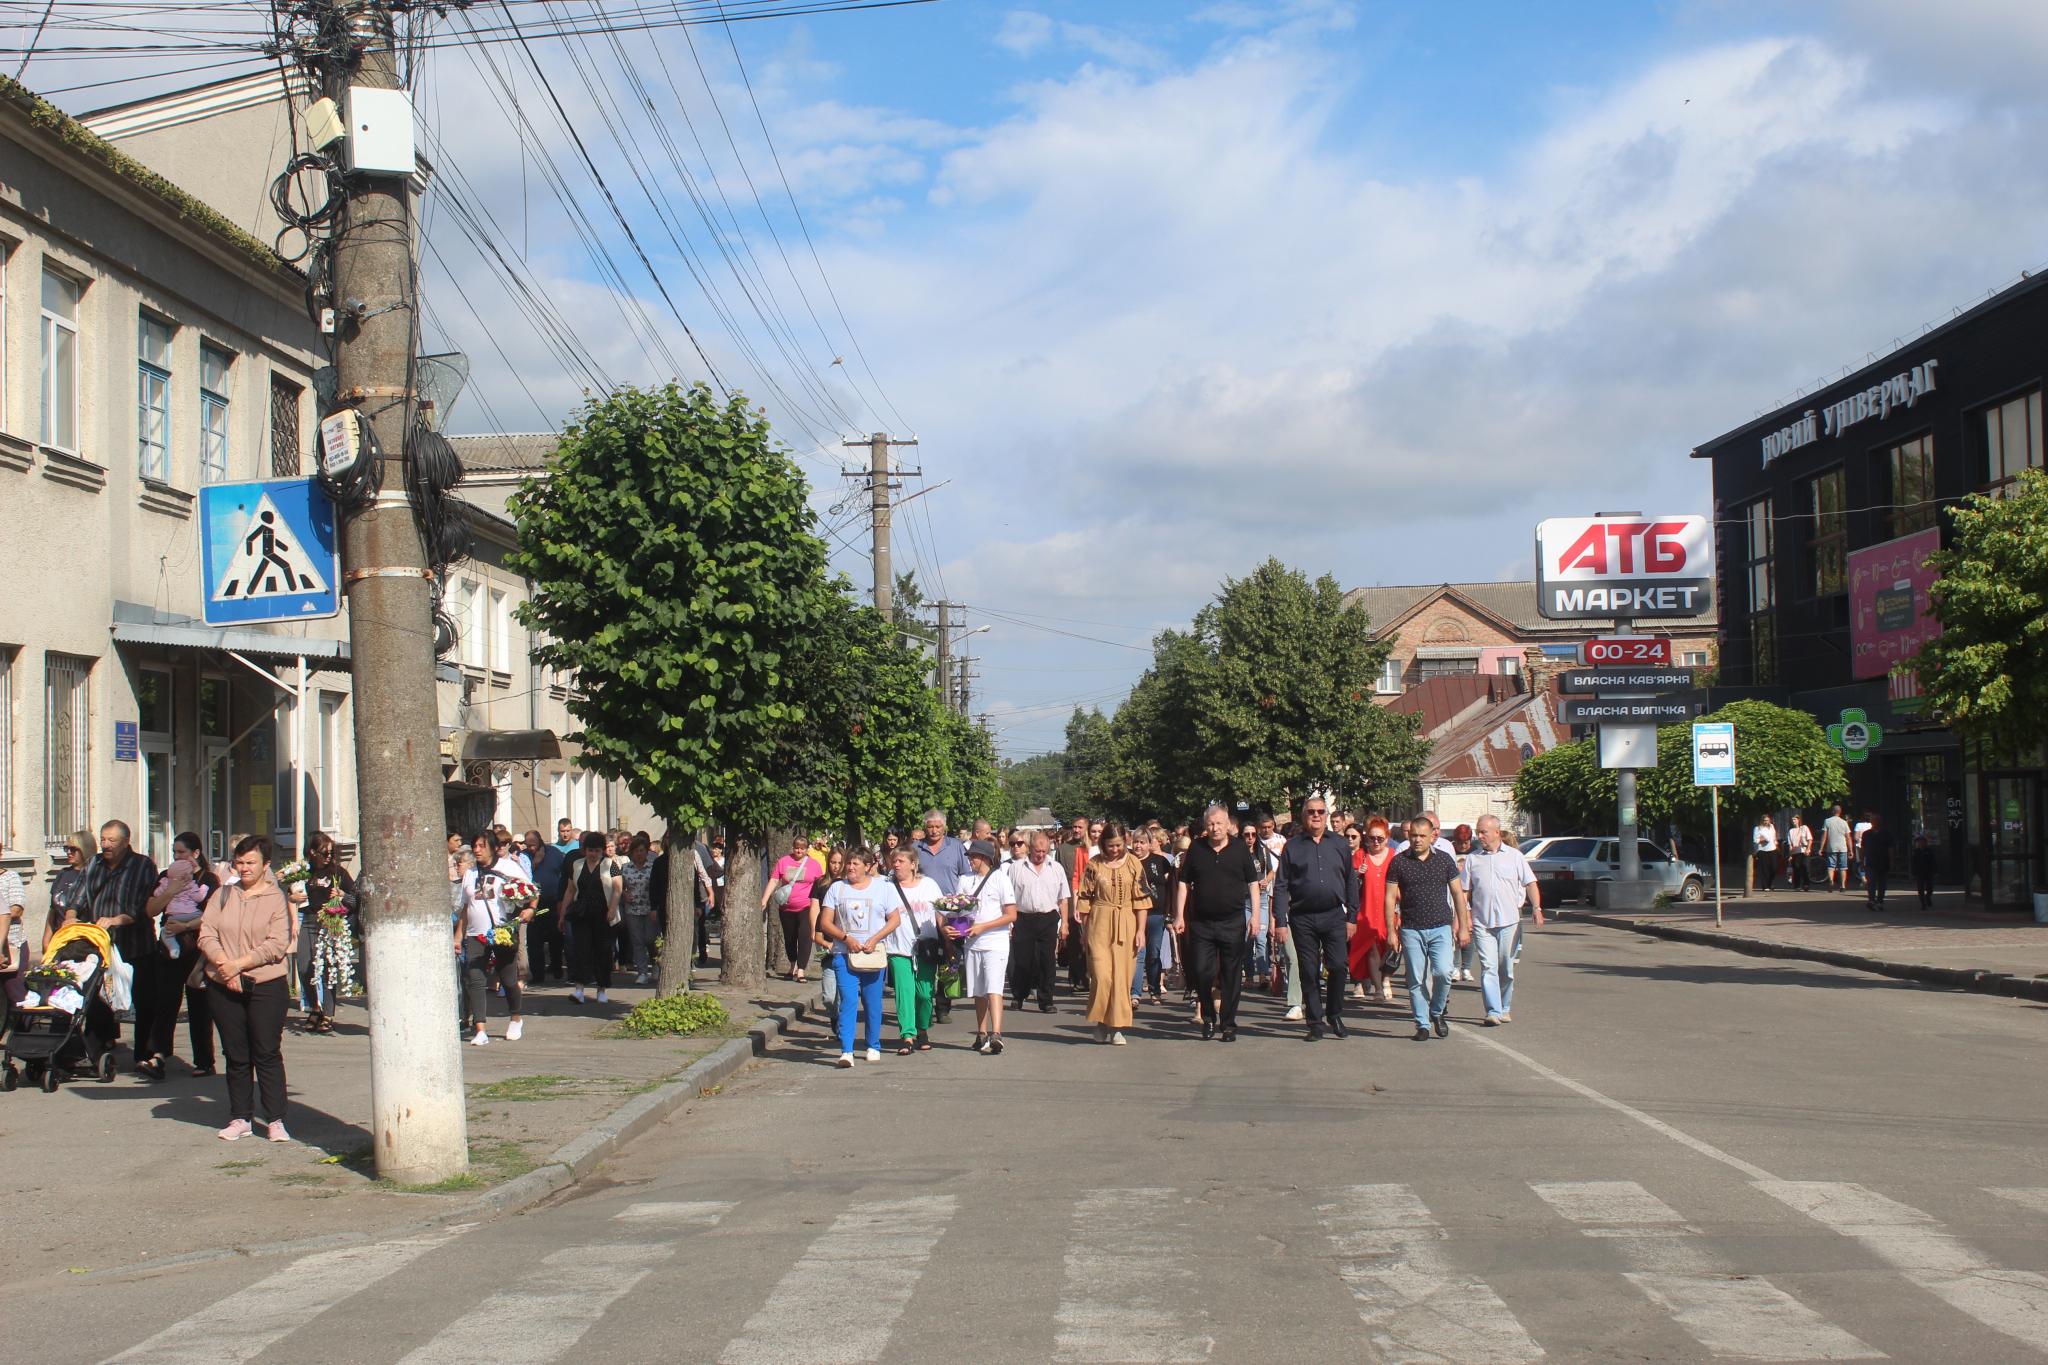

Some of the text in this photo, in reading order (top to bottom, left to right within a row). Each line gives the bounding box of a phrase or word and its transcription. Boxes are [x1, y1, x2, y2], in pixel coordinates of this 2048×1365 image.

[1761, 358, 1939, 471] НОВИЙ УНІВЕРМАГ
[1558, 521, 1690, 575] АТБ
[1555, 586, 1700, 612] МАРКЕТ
[1591, 644, 1665, 660] 00-24
[1574, 675, 1690, 686] ВЛАСНА КАВ'ЯРНЯ
[1577, 705, 1686, 716] ВЛАСНА ВИПІЧКА
